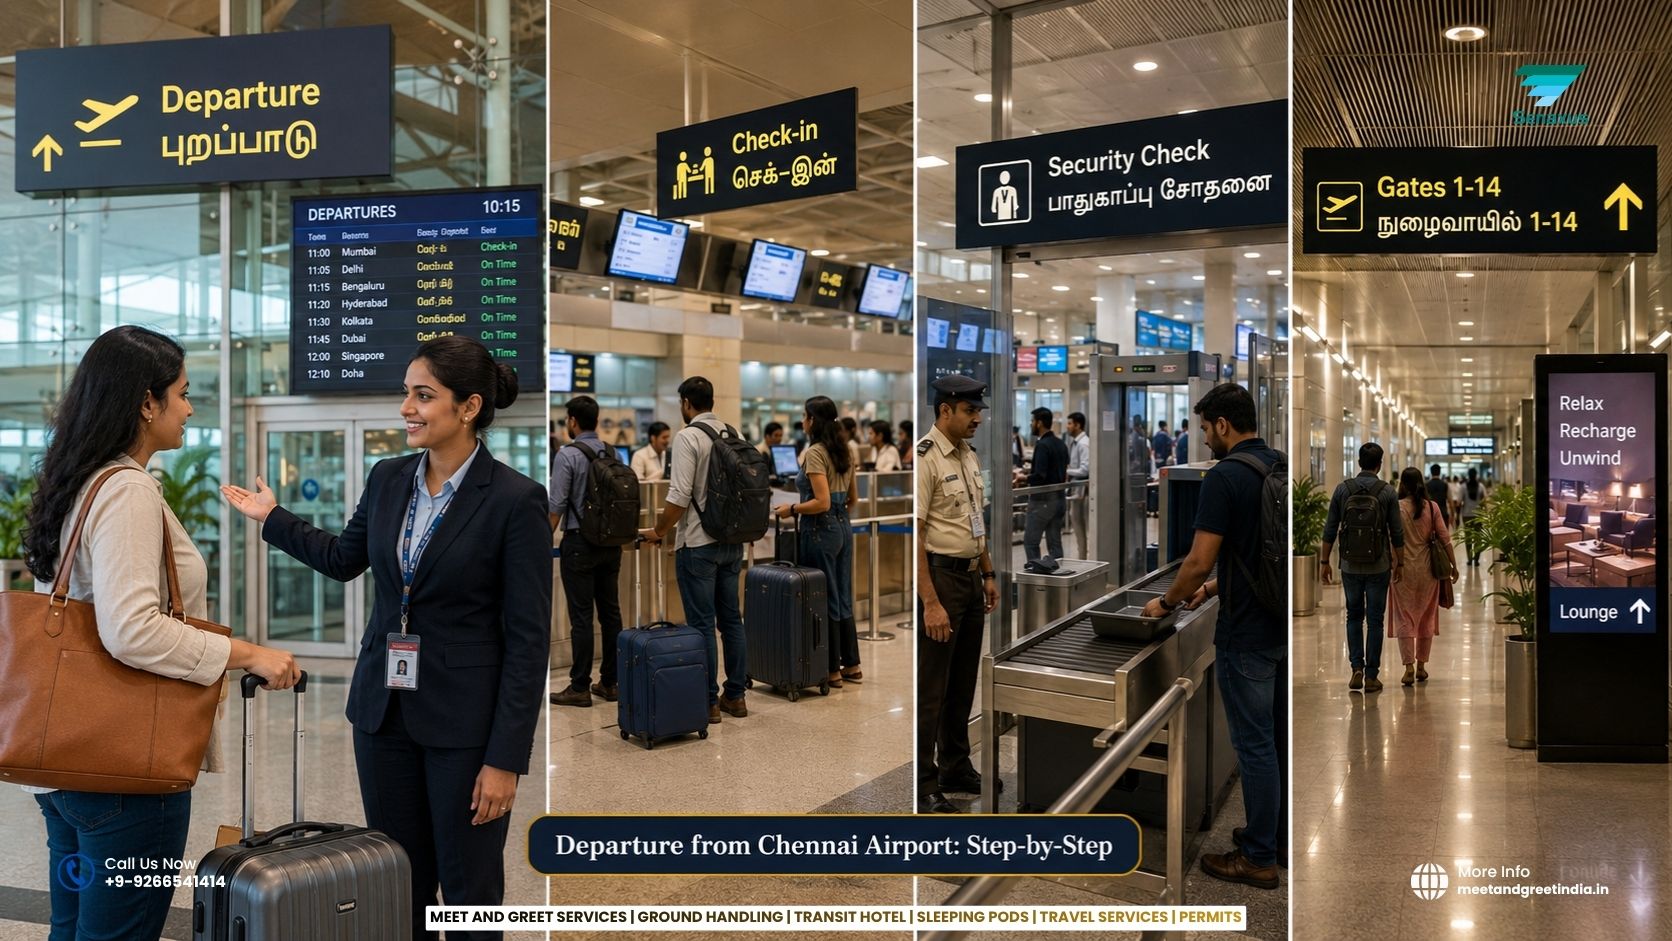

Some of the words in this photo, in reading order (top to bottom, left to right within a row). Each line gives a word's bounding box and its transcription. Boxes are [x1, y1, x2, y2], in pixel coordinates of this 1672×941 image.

[162, 81, 321, 118] Departure
[162, 120, 317, 166] புறப்பாடு
[732, 119, 818, 154] Check-in
[1048, 149, 1135, 177] Security
[1141, 138, 1211, 168] Check
[732, 152, 838, 190] செக்-இன்
[1048, 182, 1153, 216] பாதுகாப்பு
[1160, 173, 1273, 204] சோதனை
[1377, 176, 1446, 198] Gates
[1453, 176, 1502, 198] 1-14
[308, 205, 397, 222] DEPARTURES
[482, 199, 521, 214] 10:15
[1377, 209, 1522, 239] நுழைவாயில்
[1530, 211, 1578, 232] 1-14
[308, 249, 331, 258] 11:00
[341, 246, 377, 257] Mumbai
[480, 241, 518, 252] Check-in
[308, 266, 331, 275] 11:05
[341, 264, 364, 274] Delhi
[480, 260, 494, 270] On
[496, 259, 517, 269] Time
[308, 283, 331, 292] 11:15
[341, 281, 385, 294] Bengaluru
[480, 278, 494, 287] On
[496, 277, 517, 286] Time
[308, 300, 331, 310] 11:20
[341, 298, 388, 310] Hyderabad
[480, 296, 494, 305] On
[496, 295, 517, 304] Time
[308, 317, 331, 327] 11:30
[341, 316, 374, 327] Kolkata
[480, 313, 494, 323] On
[496, 312, 517, 322] Time
[308, 335, 331, 344] 11:45
[341, 333, 367, 344] Dubai
[480, 331, 494, 340] On
[496, 330, 517, 339] Time
[308, 352, 331, 362] 12:00
[341, 351, 385, 364] Singapore
[496, 348, 517, 357] Time
[308, 370, 331, 379] 12:10
[341, 368, 364, 379] Doha
[1560, 395, 1604, 411] Relax
[1560, 423, 1636, 442] Recharge
[1560, 450, 1621, 466] Unwind
[1560, 604, 1618, 622] Lounge
